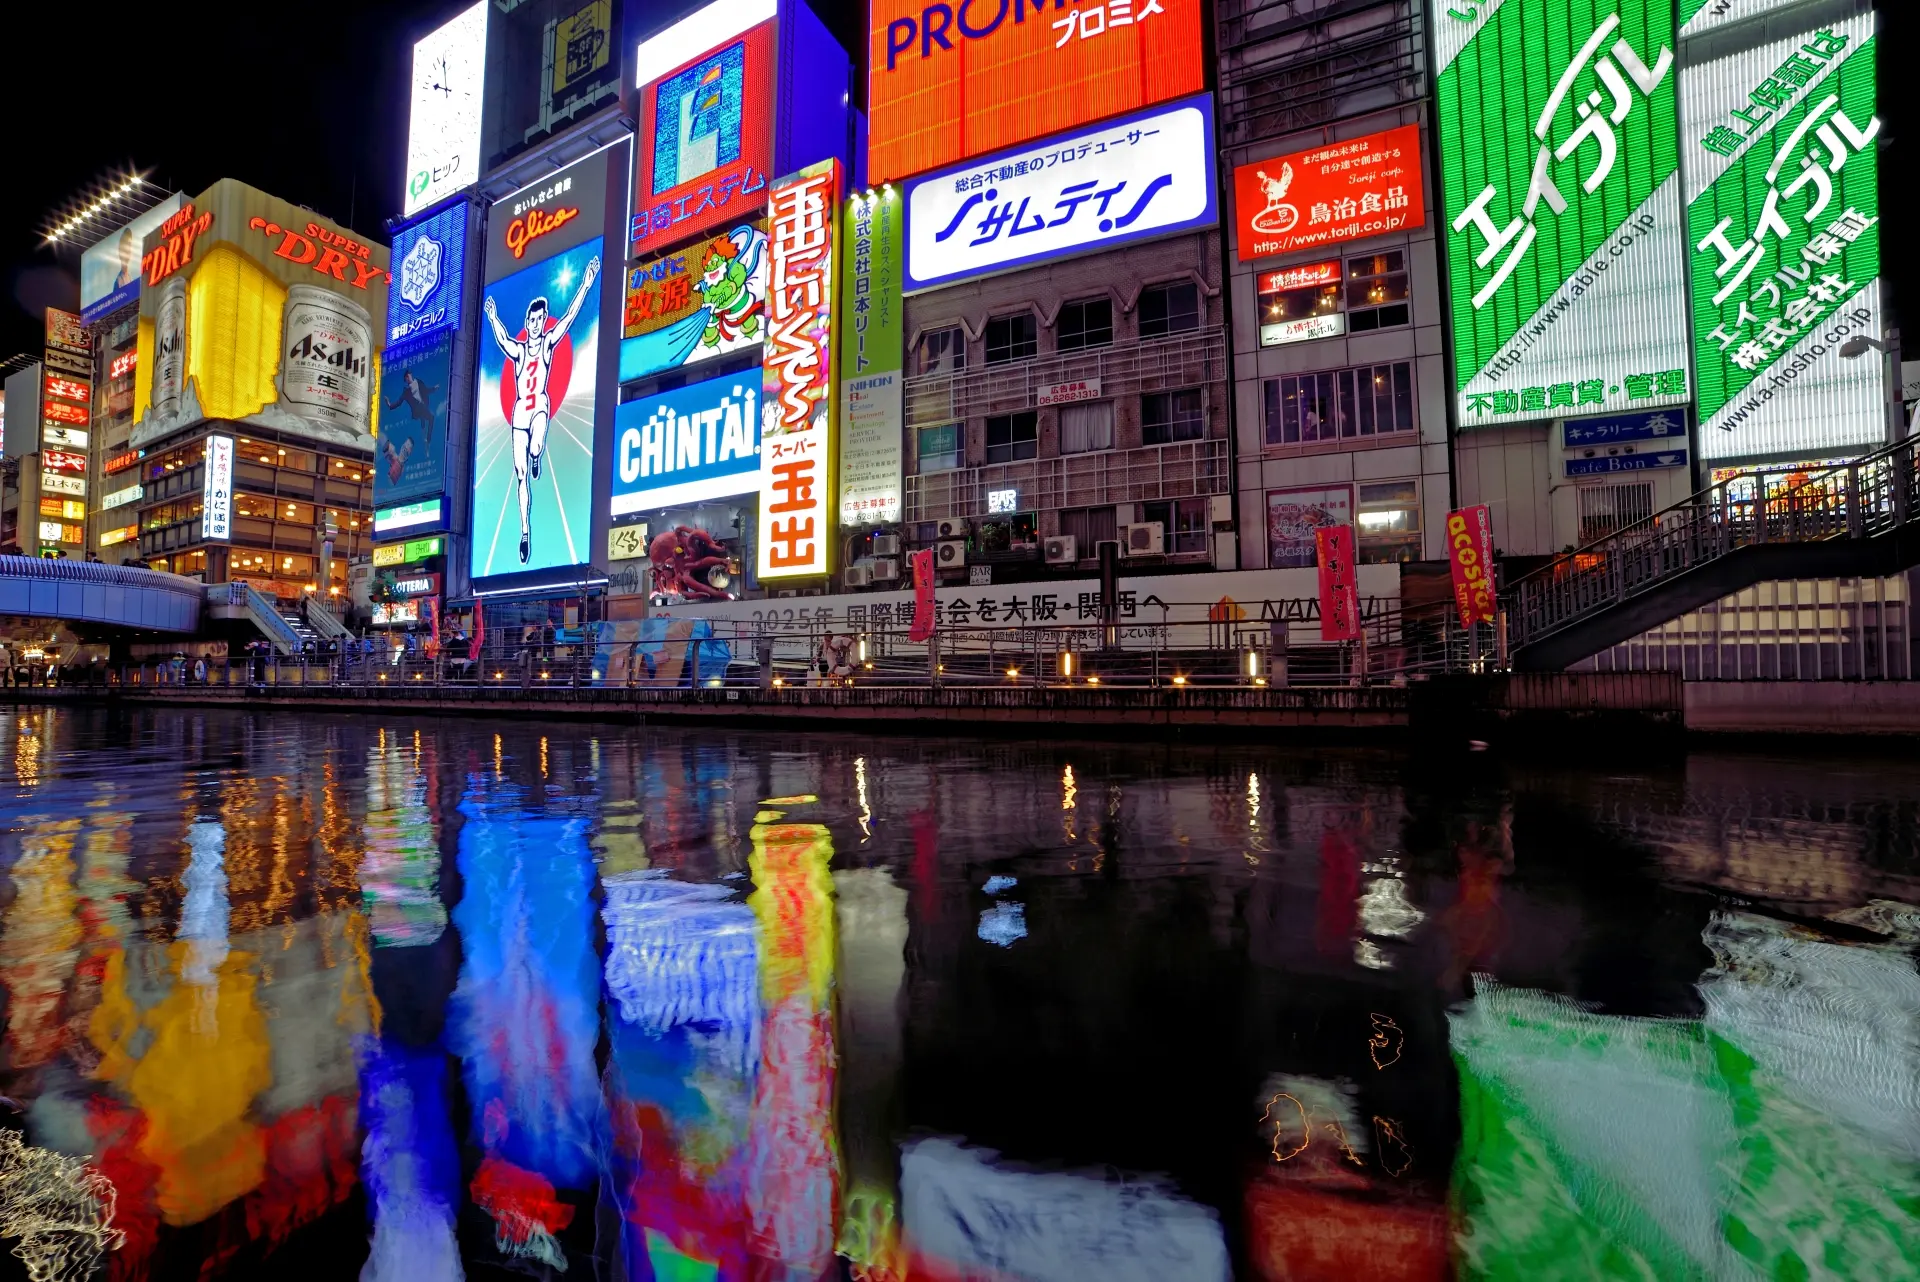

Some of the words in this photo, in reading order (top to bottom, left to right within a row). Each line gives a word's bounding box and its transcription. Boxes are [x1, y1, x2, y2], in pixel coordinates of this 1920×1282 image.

[1700, 28, 1850, 157] 借上保証は
[955, 129, 1160, 194] 総合不動産のプロデューサー
[1321, 148, 1401, 174] 自分達で創造する
[1451, 36, 1674, 274] エイブル
[514, 177, 572, 215] おいしさと健康
[631, 167, 766, 241] 日商エステム
[1308, 185, 1409, 226] 鳥治食品
[1697, 106, 1881, 282] エイブル
[161, 204, 196, 240] SUPER
[304, 222, 372, 260] SUPER
[506, 207, 579, 258] Glico
[1254, 213, 1406, 254] http://www.toriji.co.jp/
[630, 255, 687, 290] かぜに
[854, 200, 872, 373] 株式会社日本リート
[1705, 206, 1880, 351] エイブル保証
[624, 273, 693, 327] 改源
[1484, 213, 1655, 382] http://www.able.co.jp
[392, 307, 445, 340] 雪印メグミルク
[1730, 273, 1856, 371] 株式会社
[290, 333, 366, 379] Asahi
[1719, 306, 1872, 433] www.a-hosho.co.jp
[317, 374, 339, 391] 生
[525, 356, 539, 412] グリコ
[850, 376, 892, 391] NIHON
[1040, 389, 1098, 404] 06-6262-1313
[1466, 368, 1687, 418] 不動産賃貸・管理
[1639, 413, 1680, 436] 香
[772, 440, 817, 459] スーパー
[1609, 458, 1645, 471] Bon
[44, 475, 83, 493] 白木屋
[769, 459, 817, 568] 玉出
[844, 497, 896, 511] 広告主募集中
[393, 577, 430, 594] OTTERIA
[971, 566, 990, 577] BAR
[752, 606, 834, 632] 2025年
[1261, 595, 1375, 622] NANI
